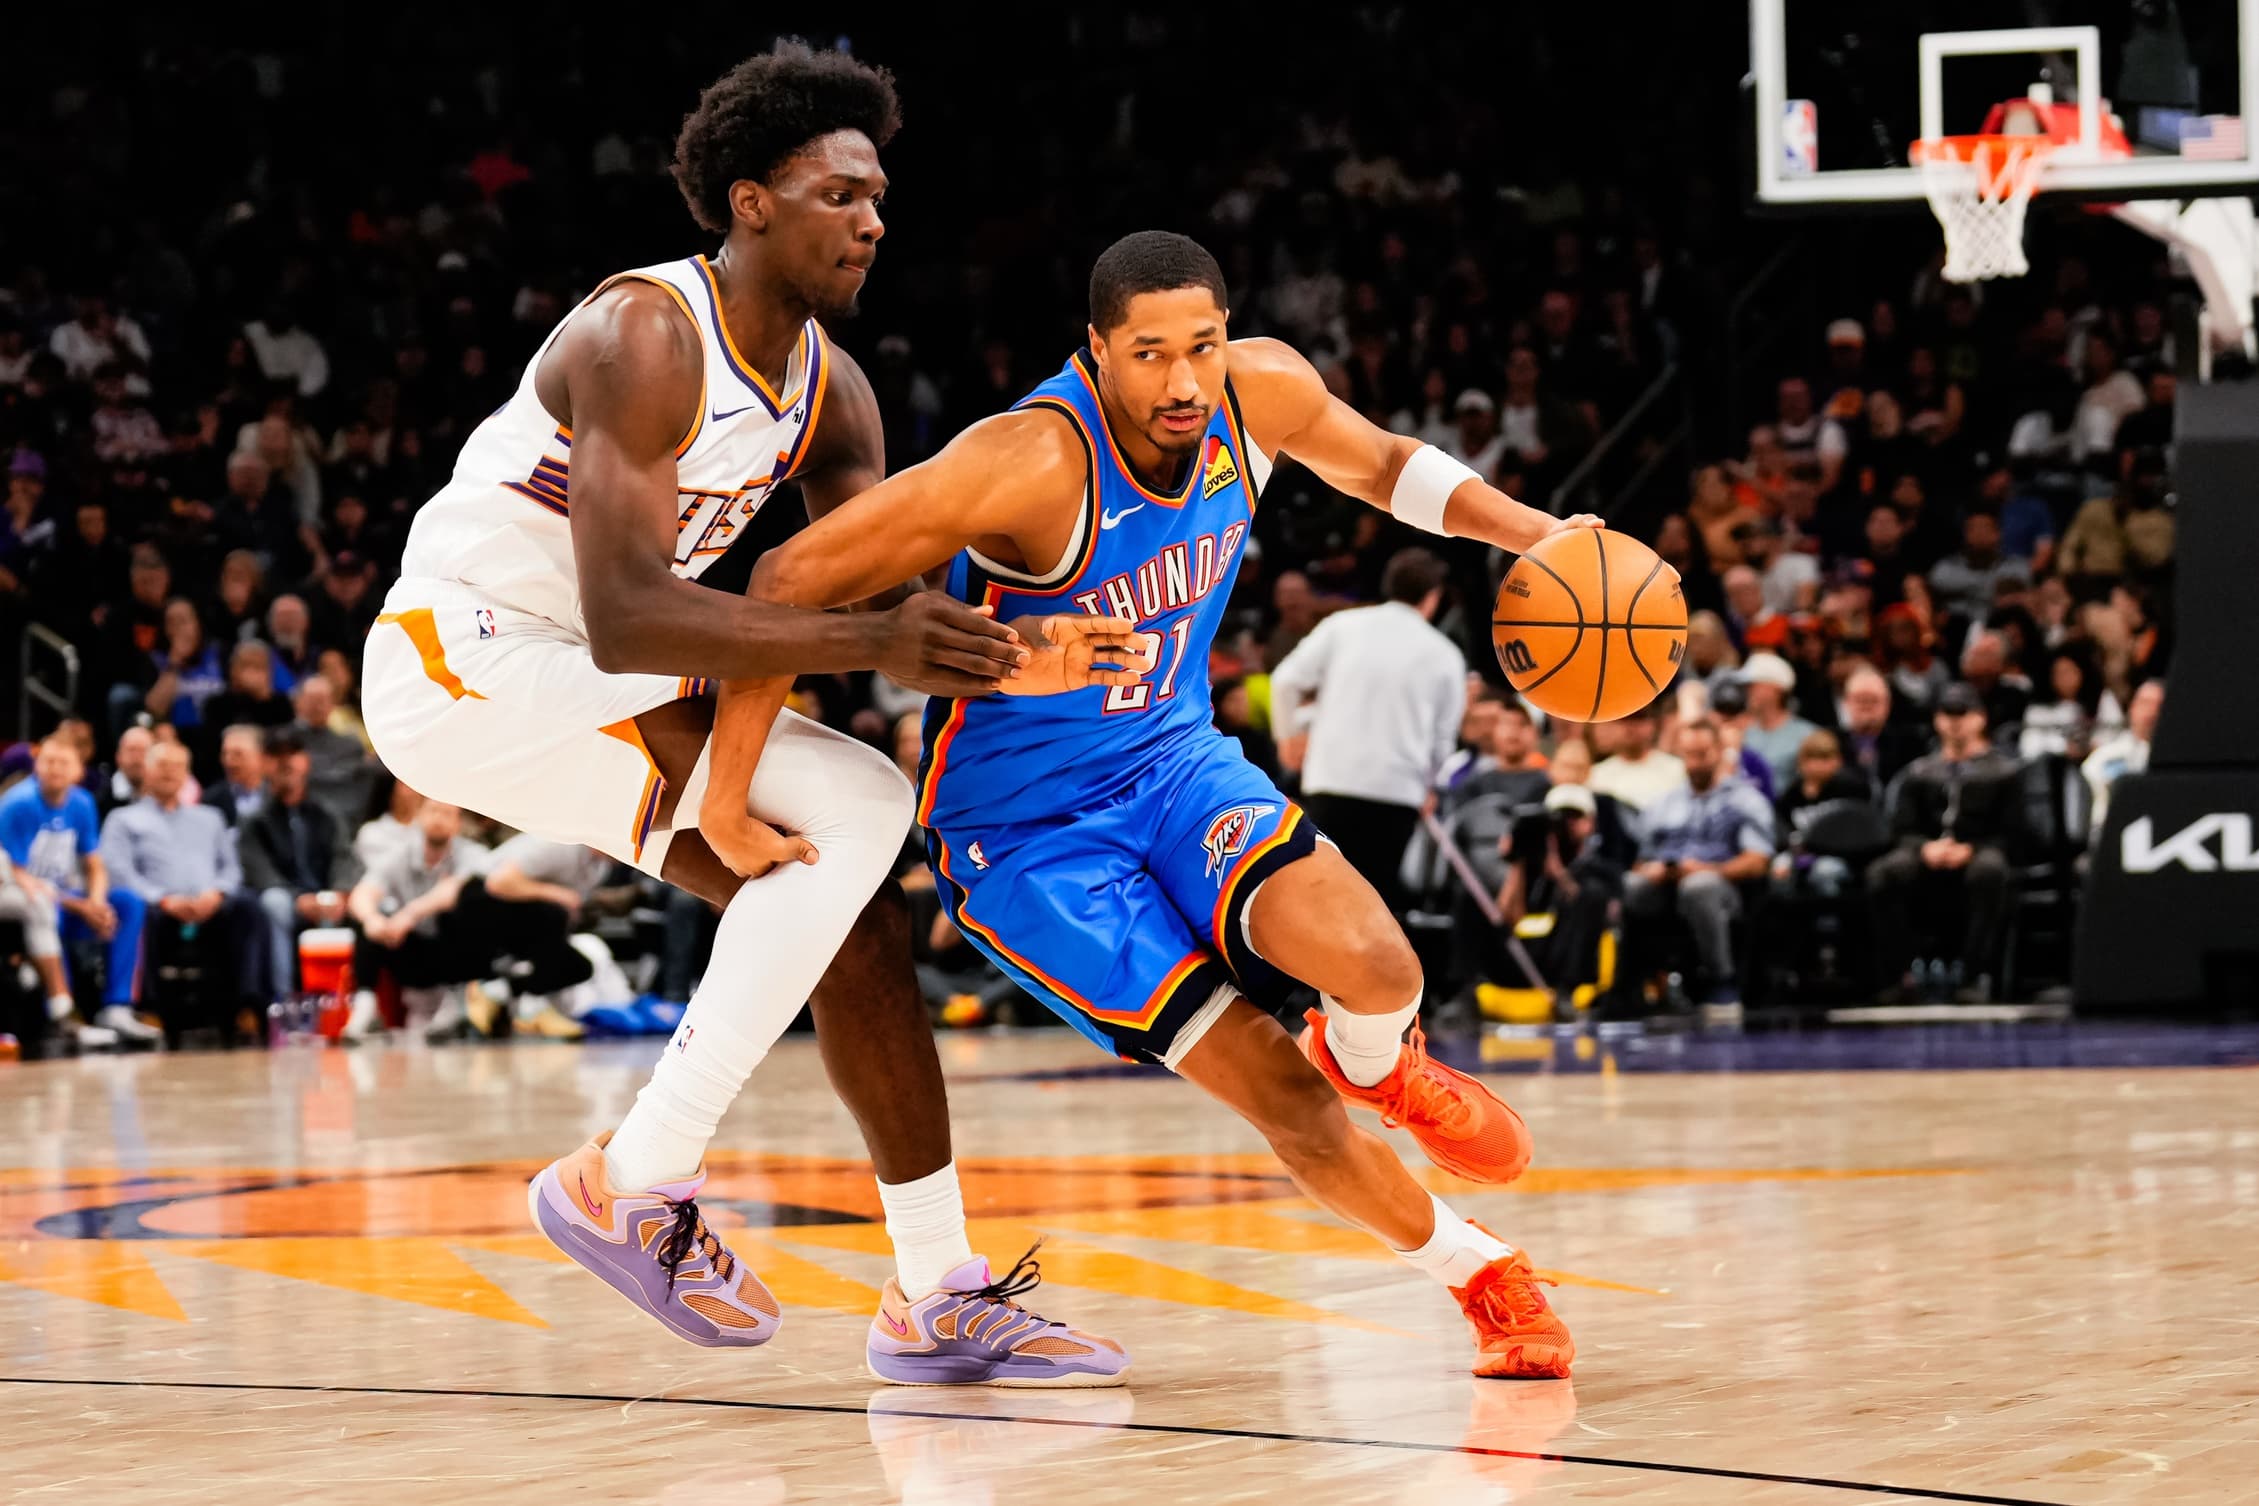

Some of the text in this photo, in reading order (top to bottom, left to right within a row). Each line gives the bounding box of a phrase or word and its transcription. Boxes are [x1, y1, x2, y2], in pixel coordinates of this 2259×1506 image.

[1075, 521, 1247, 626] THUNDER
[1103, 615, 1195, 714] 21
[2121, 812, 2259, 873] KI
